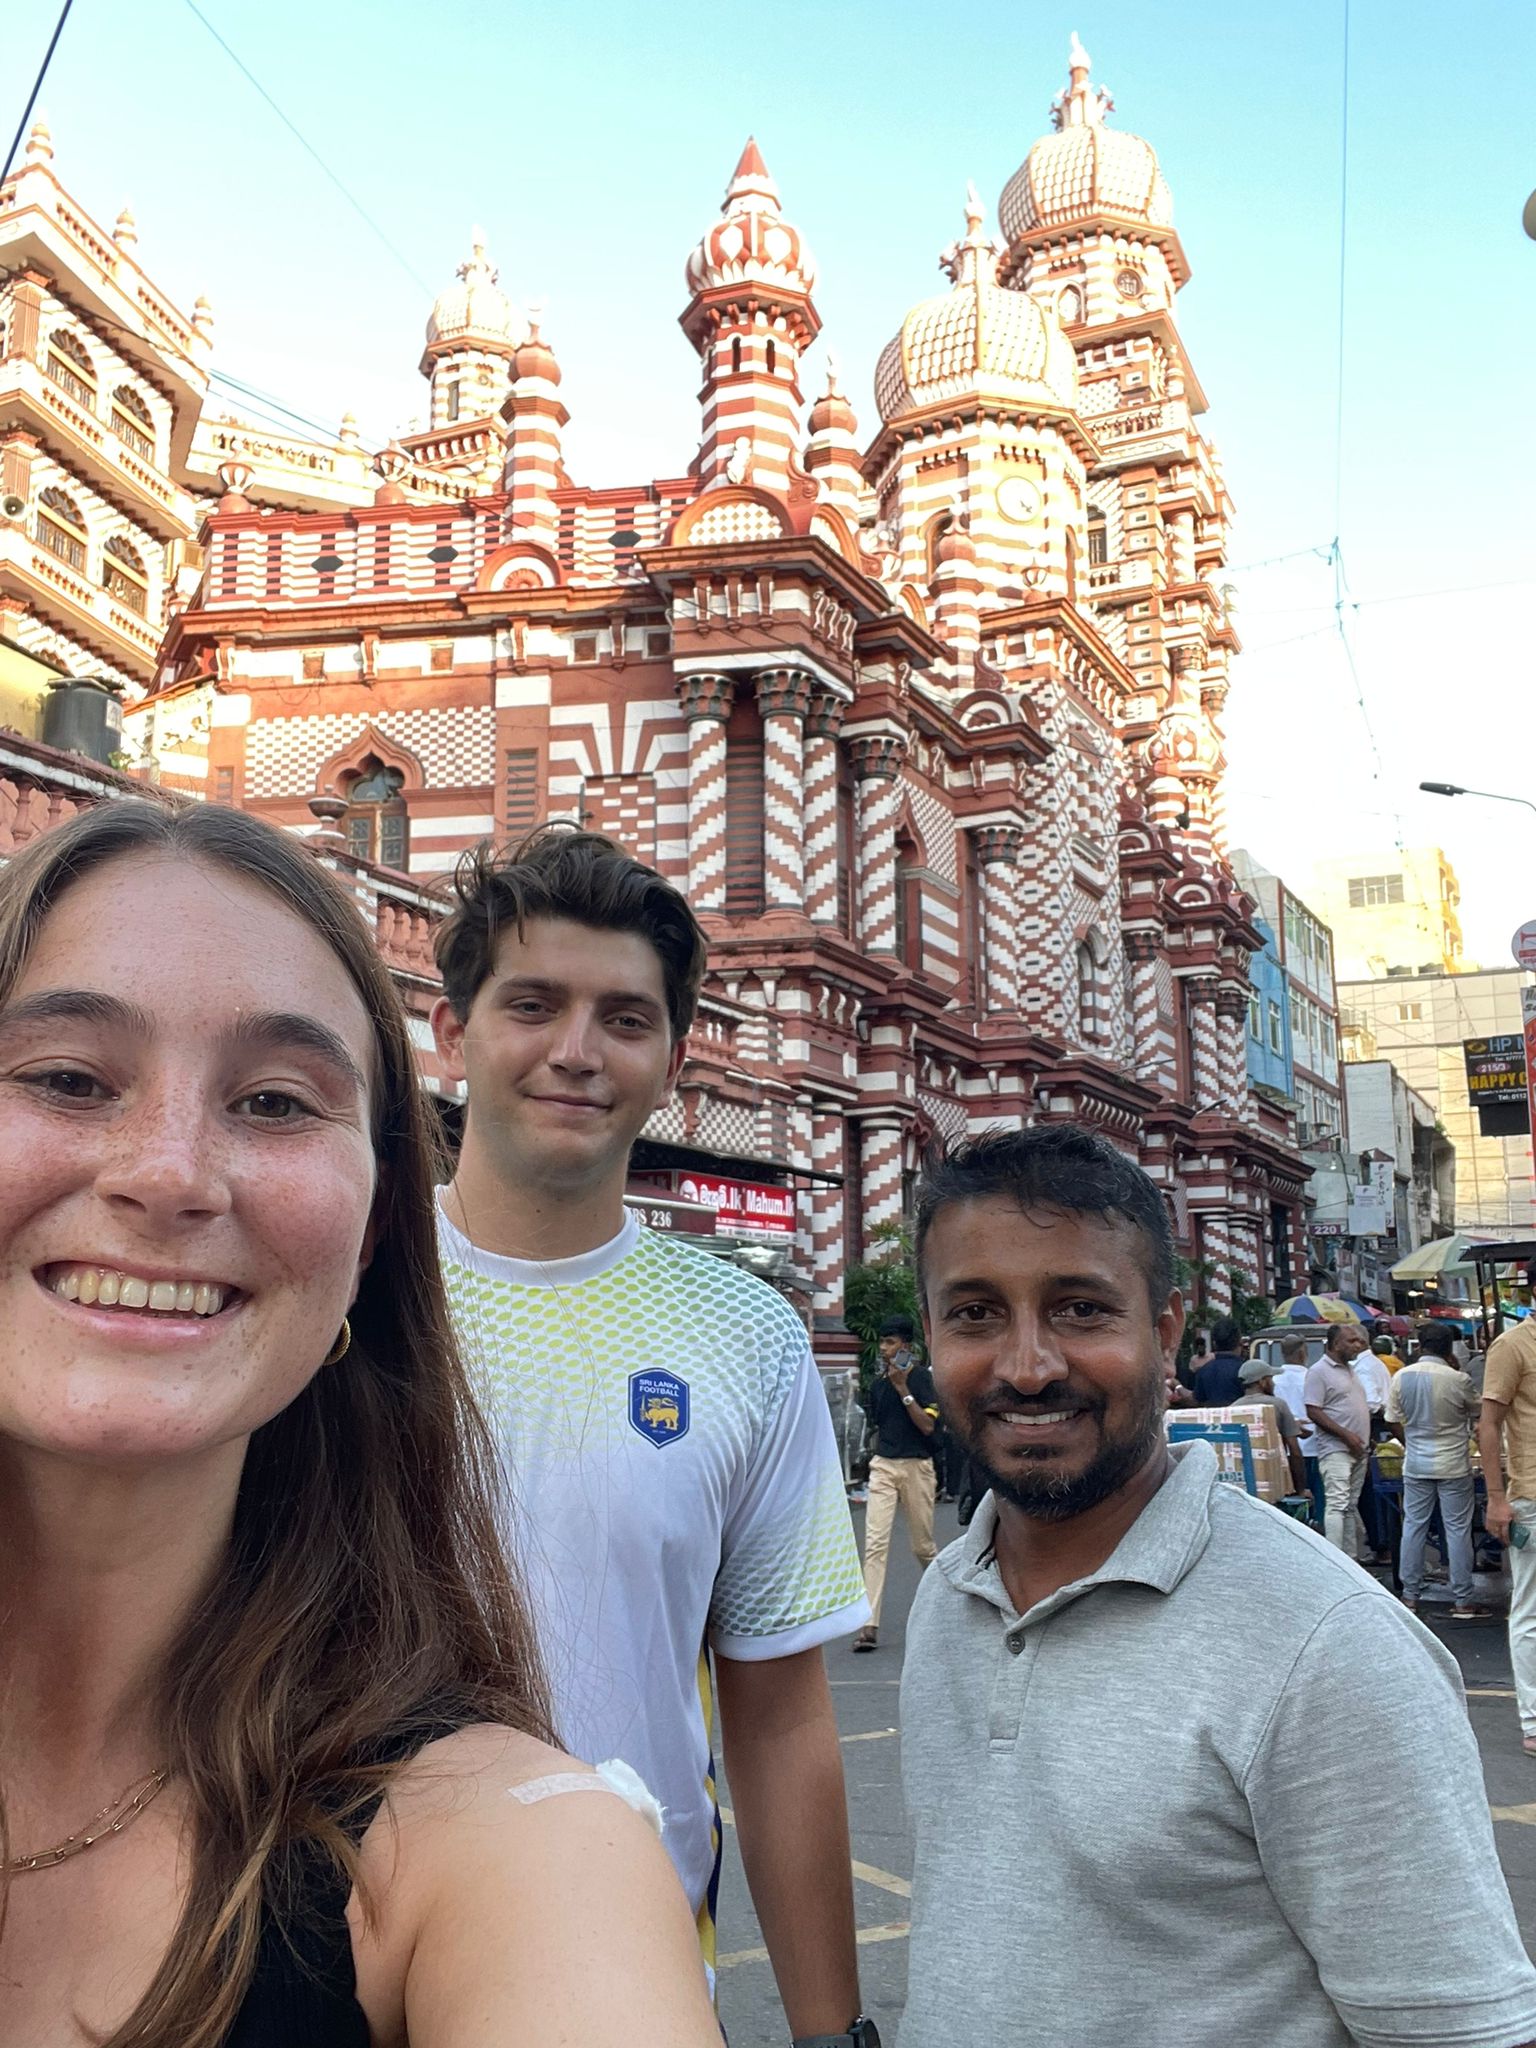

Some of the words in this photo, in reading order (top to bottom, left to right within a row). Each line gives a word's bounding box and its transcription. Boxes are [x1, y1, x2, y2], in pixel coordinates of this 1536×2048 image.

[1489, 1037, 1512, 1051] HP
[1469, 1072, 1517, 1089] HAPPY
[746, 1189, 795, 1217] Mahum.lk
[651, 1210, 672, 1228] 236
[1314, 1225, 1338, 1235] 220
[639, 1379, 653, 1387] SRI
[653, 1380, 680, 1390] LANKA
[639, 1386, 680, 1397] FOOTBALL
